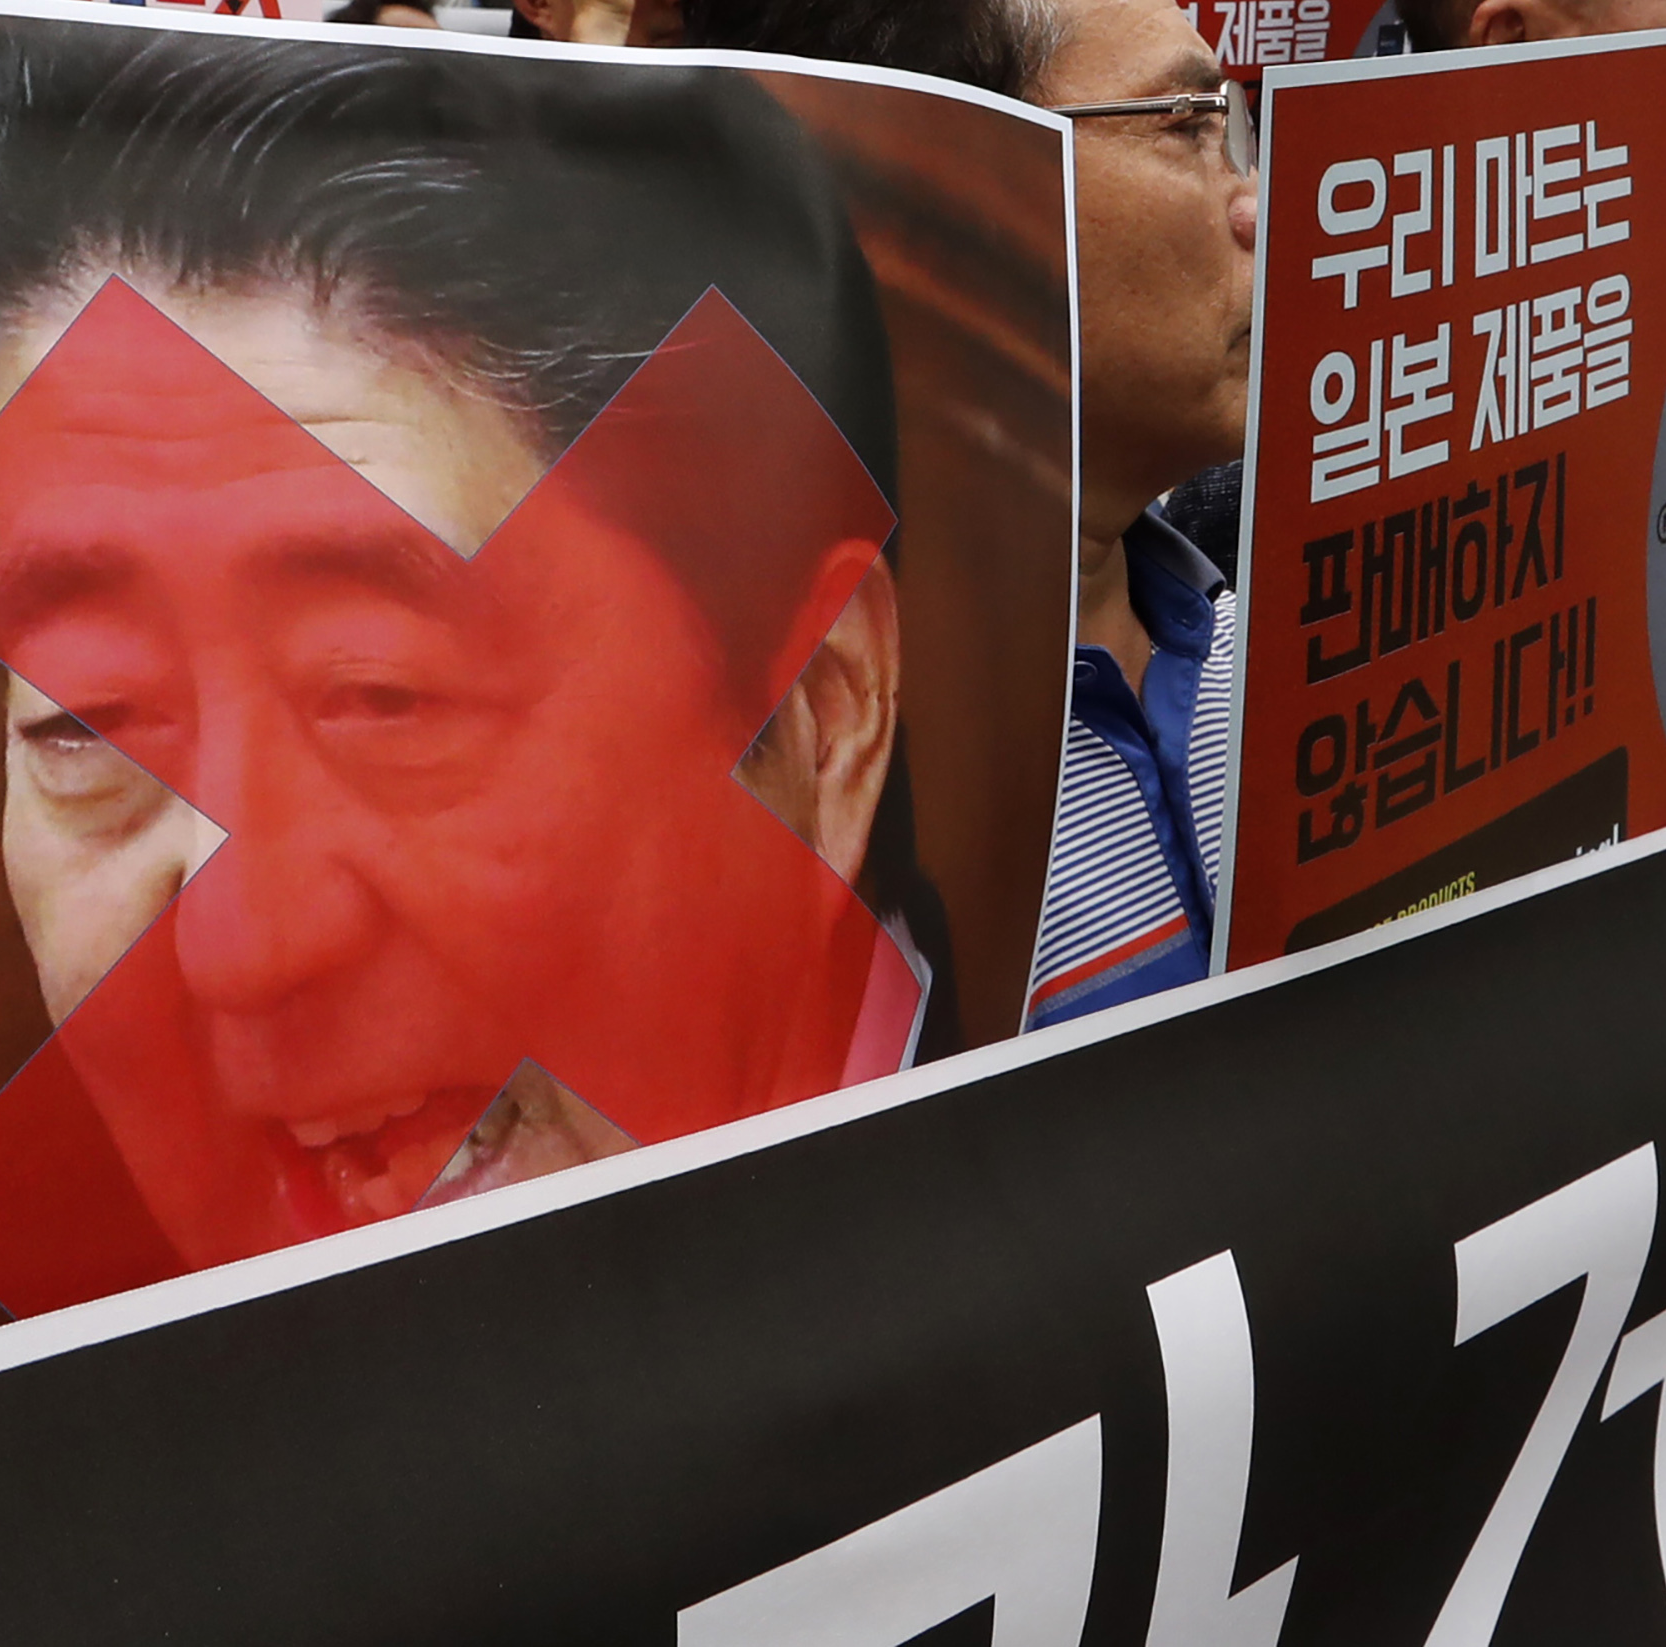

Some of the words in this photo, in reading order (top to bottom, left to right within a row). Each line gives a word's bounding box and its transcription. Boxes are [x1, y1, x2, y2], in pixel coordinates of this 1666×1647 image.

[1310, 144, 1455, 310] 우리
[1474, 120, 1632, 278] 마트는
[1309, 322, 1454, 504] 일본
[1469, 273, 1633, 453] 제품을
[1299, 452, 1567, 686] 판매하지
[1295, 596, 1597, 867] 않습니다!!
